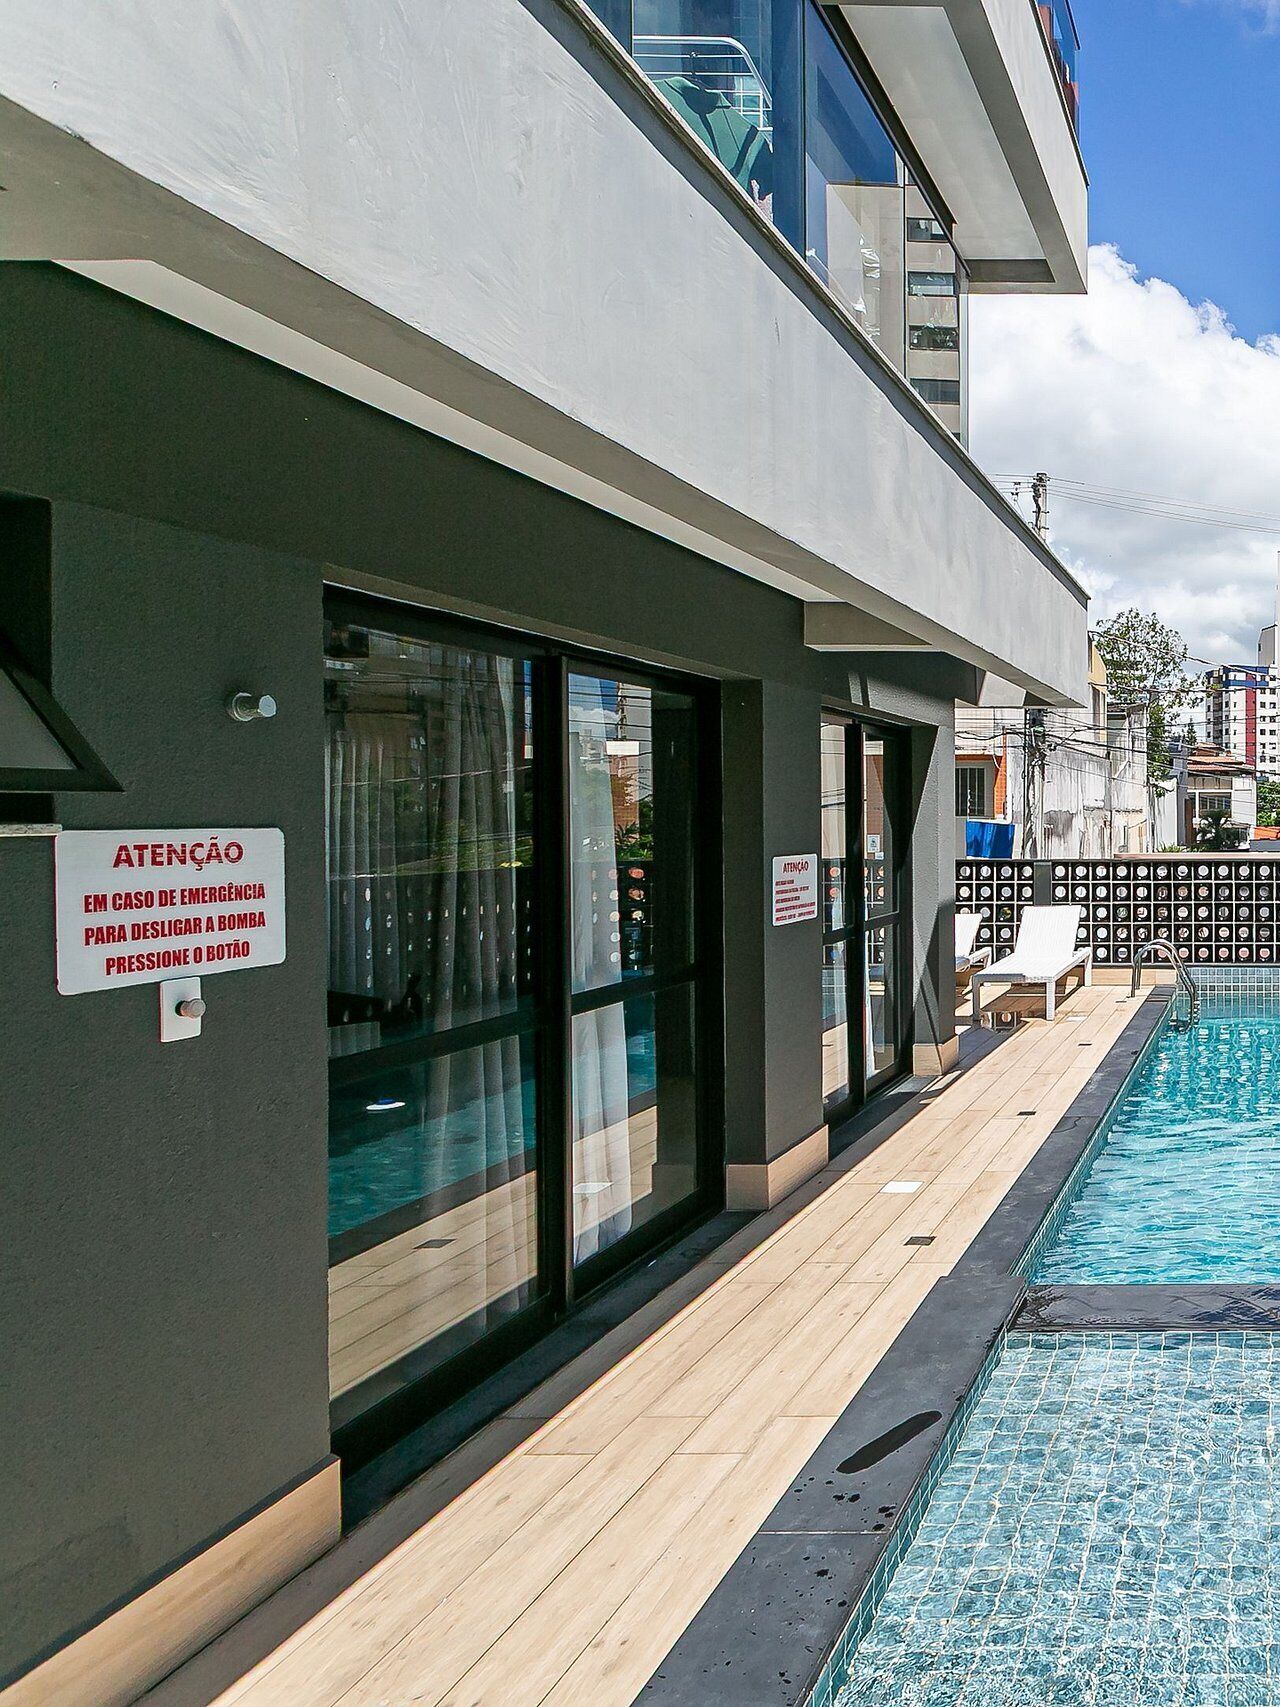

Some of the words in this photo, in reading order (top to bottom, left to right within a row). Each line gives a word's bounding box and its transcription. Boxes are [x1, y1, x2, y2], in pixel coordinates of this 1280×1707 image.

[113, 836, 244, 871] ATENÇÃO
[783, 859, 809, 874] ATENÇÃO
[84, 893, 108, 913] EM
[112, 890, 155, 911] CASO
[158, 889, 177, 907] DE
[180, 882, 266, 905] EMERGÊNCIA
[84, 924, 127, 946] PARA
[131, 917, 202, 941] DESLIGAR
[205, 916, 215, 933] A
[218, 911, 266, 931] BOMBA
[105, 949, 190, 975] PRESSIONE
[193, 946, 203, 964] O
[206, 938, 250, 962] BOTÃO
